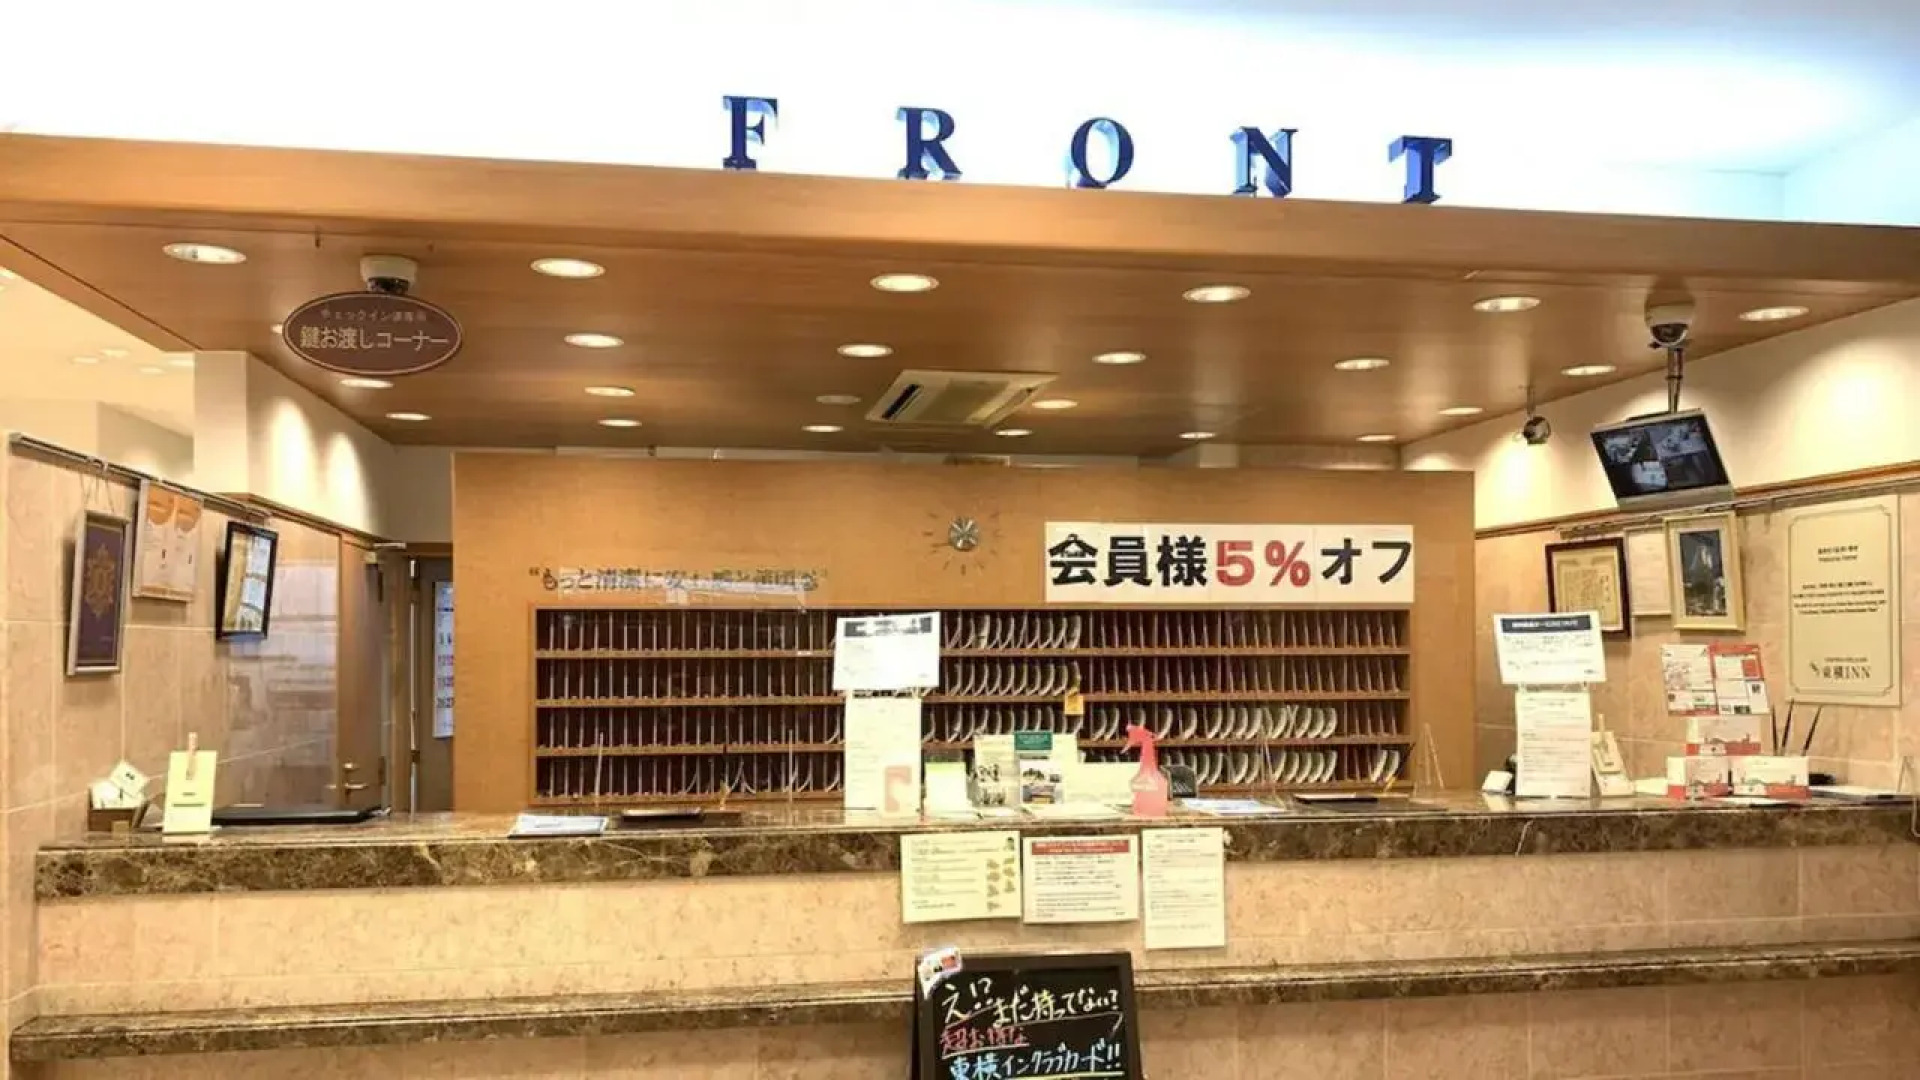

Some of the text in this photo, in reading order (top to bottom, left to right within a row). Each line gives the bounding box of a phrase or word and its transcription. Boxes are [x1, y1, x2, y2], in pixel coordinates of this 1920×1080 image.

[723, 95, 1452, 204] FRONT
[301, 325, 449, 351] 鍵お渡しコーナー
[1048, 534, 1412, 588] 会員様5%オフ
